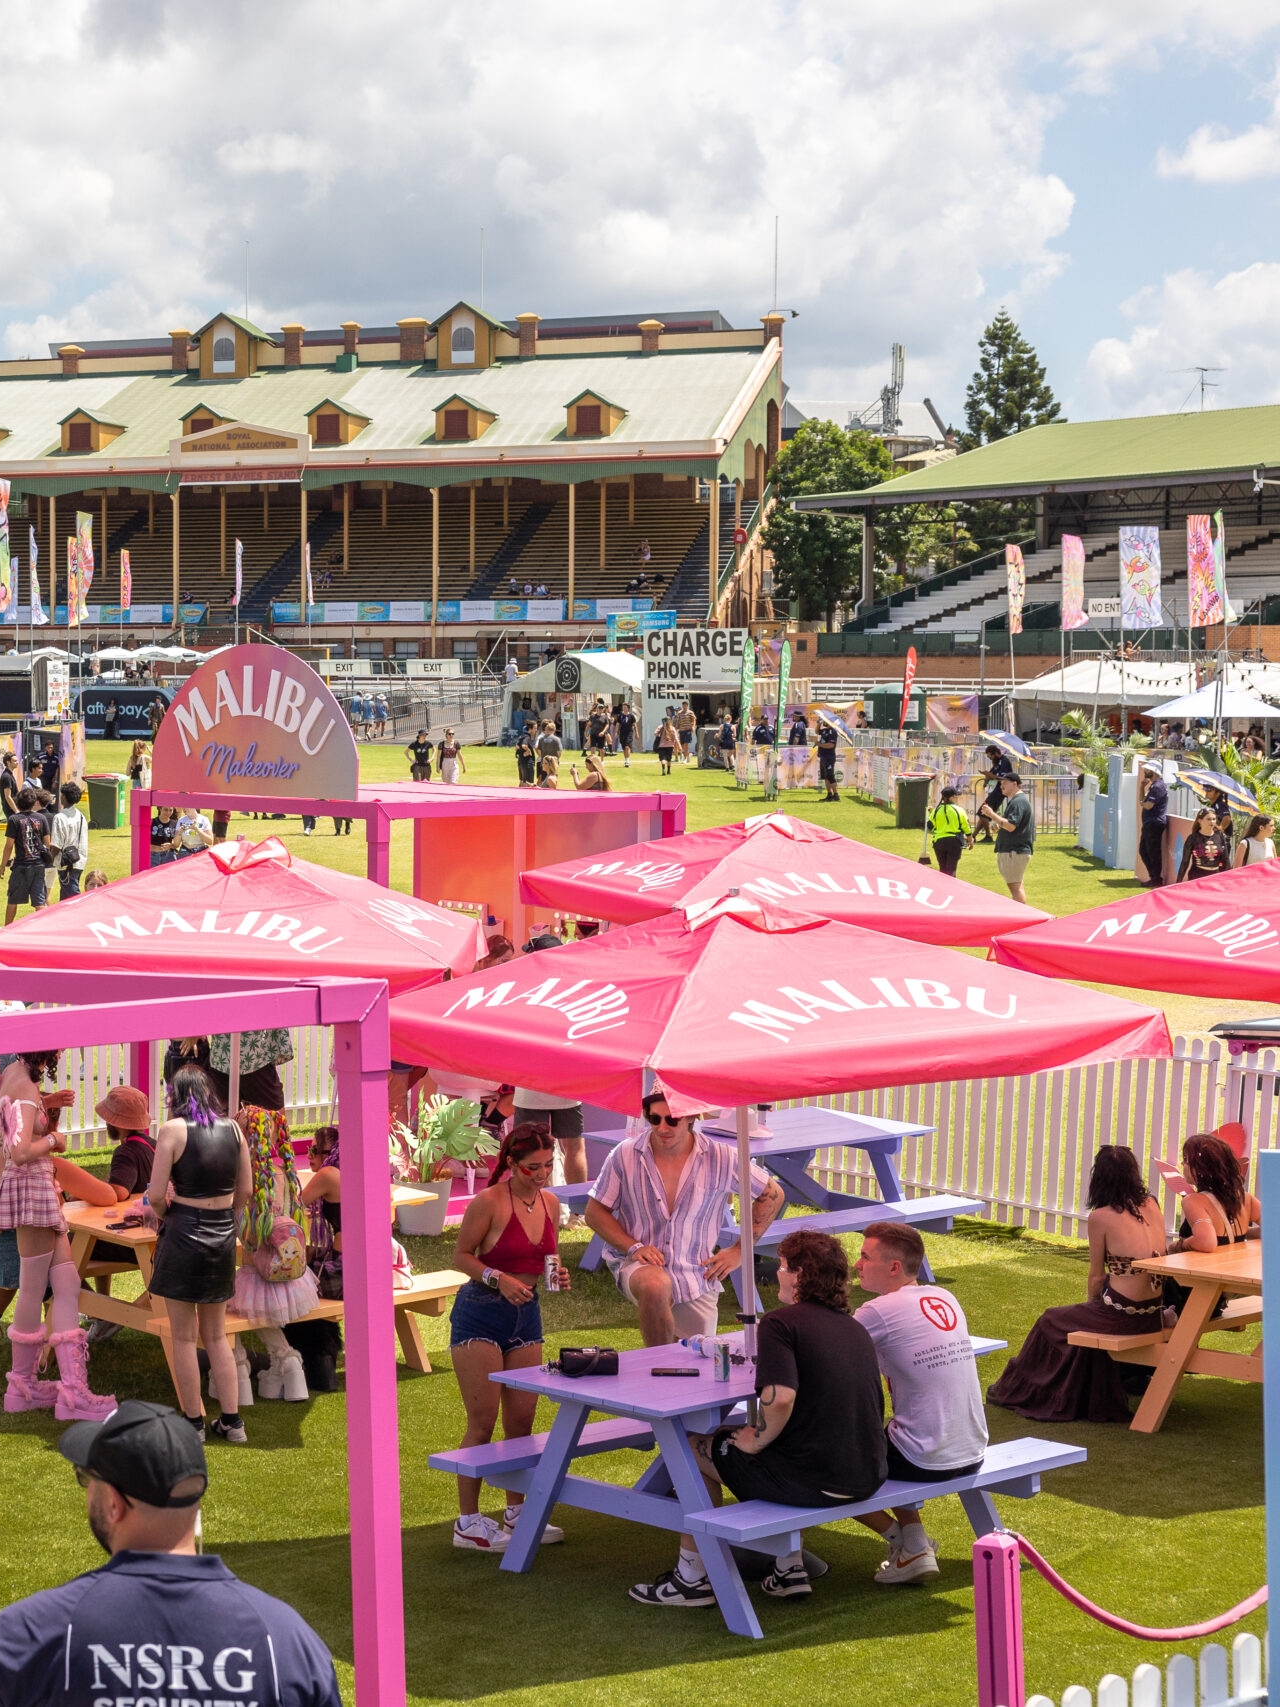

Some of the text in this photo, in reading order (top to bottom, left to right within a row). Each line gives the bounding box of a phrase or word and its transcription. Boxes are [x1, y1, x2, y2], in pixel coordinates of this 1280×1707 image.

[191, 441, 286, 451] NATIONAL ASSOCIATION
[641, 619, 670, 627] SAMSUNG
[1091, 602, 1120, 612] NO ENT
[647, 630, 743, 657] CHARGE
[335, 663, 354, 672] EXIT
[423, 663, 442, 672] EXIT
[647, 661, 701, 678] PHONE
[173, 665, 336, 757] MALIBU
[200, 741, 300, 783] Makeover
[741, 872, 954, 909] MALIBU
[86, 910, 344, 955] MALIBU
[1085, 910, 1280, 958] MALIBU
[442, 977, 631, 1040] MALIBU
[728, 977, 1017, 1044] MALIBU
[87, 1643, 257, 1693] NSRG
